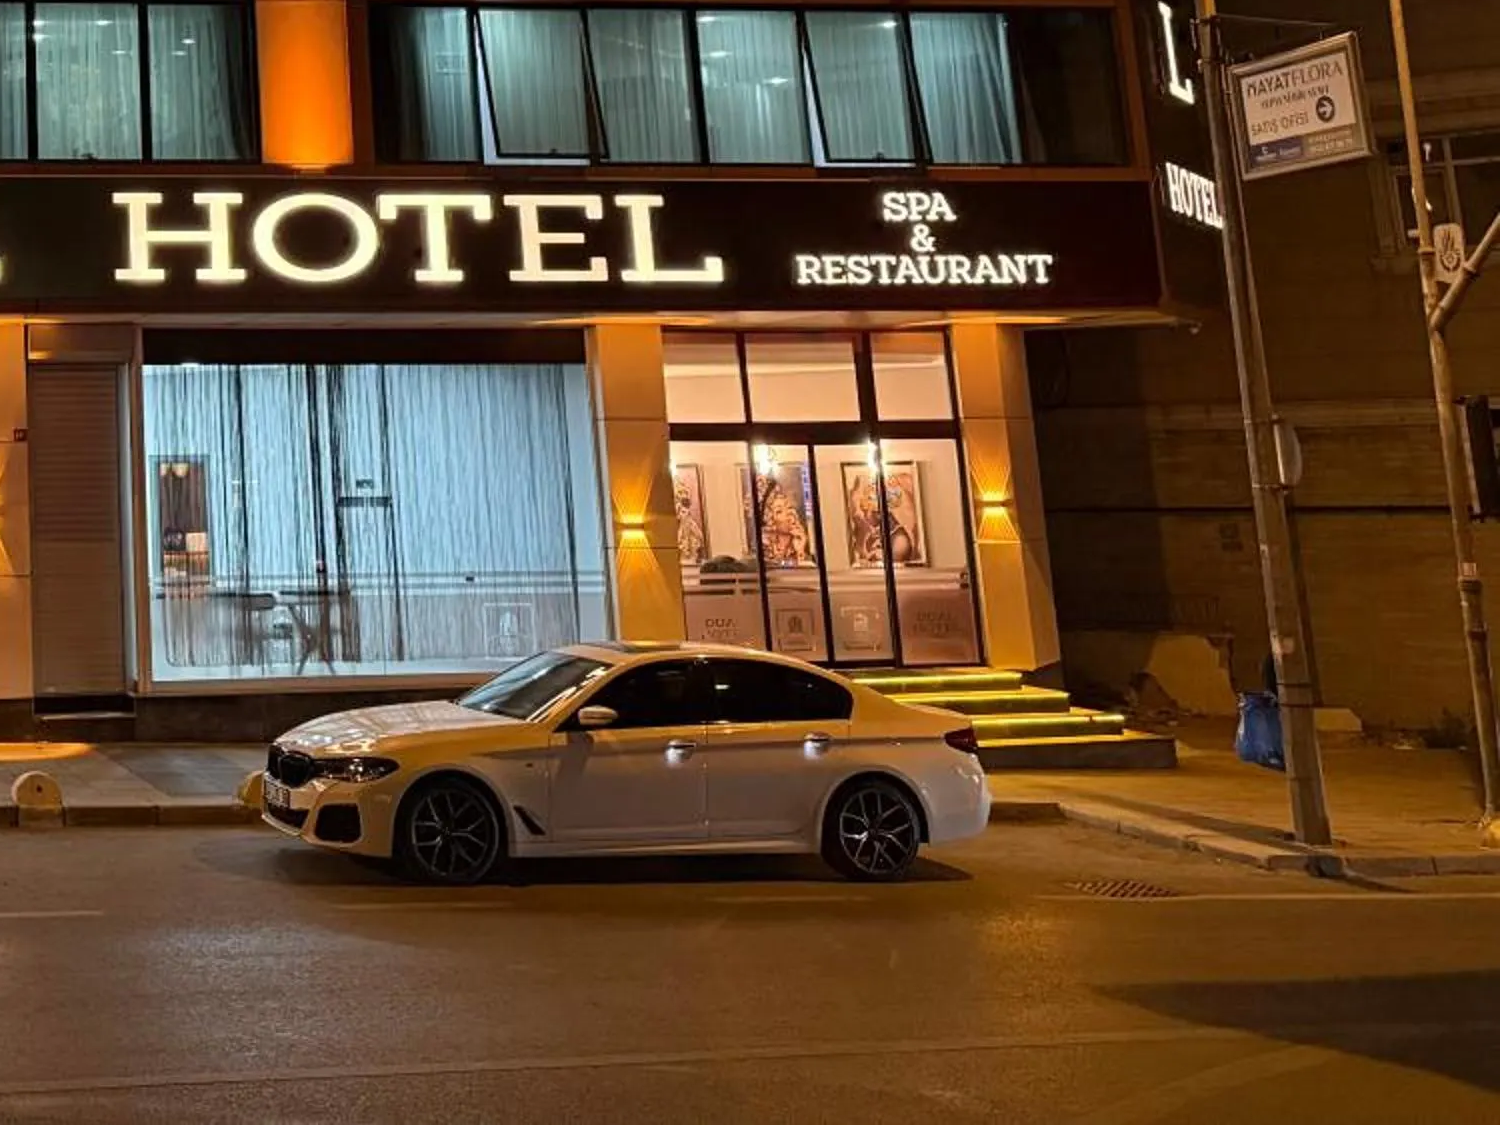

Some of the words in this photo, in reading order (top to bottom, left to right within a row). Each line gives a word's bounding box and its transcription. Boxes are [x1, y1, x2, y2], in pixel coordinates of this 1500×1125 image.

[881, 191, 957, 222] SPA
[1165, 161, 1223, 229] HOTEL
[111, 192, 725, 284] HOTEL
[909, 223, 937, 253] &
[794, 254, 1054, 285] RESTAURANT
